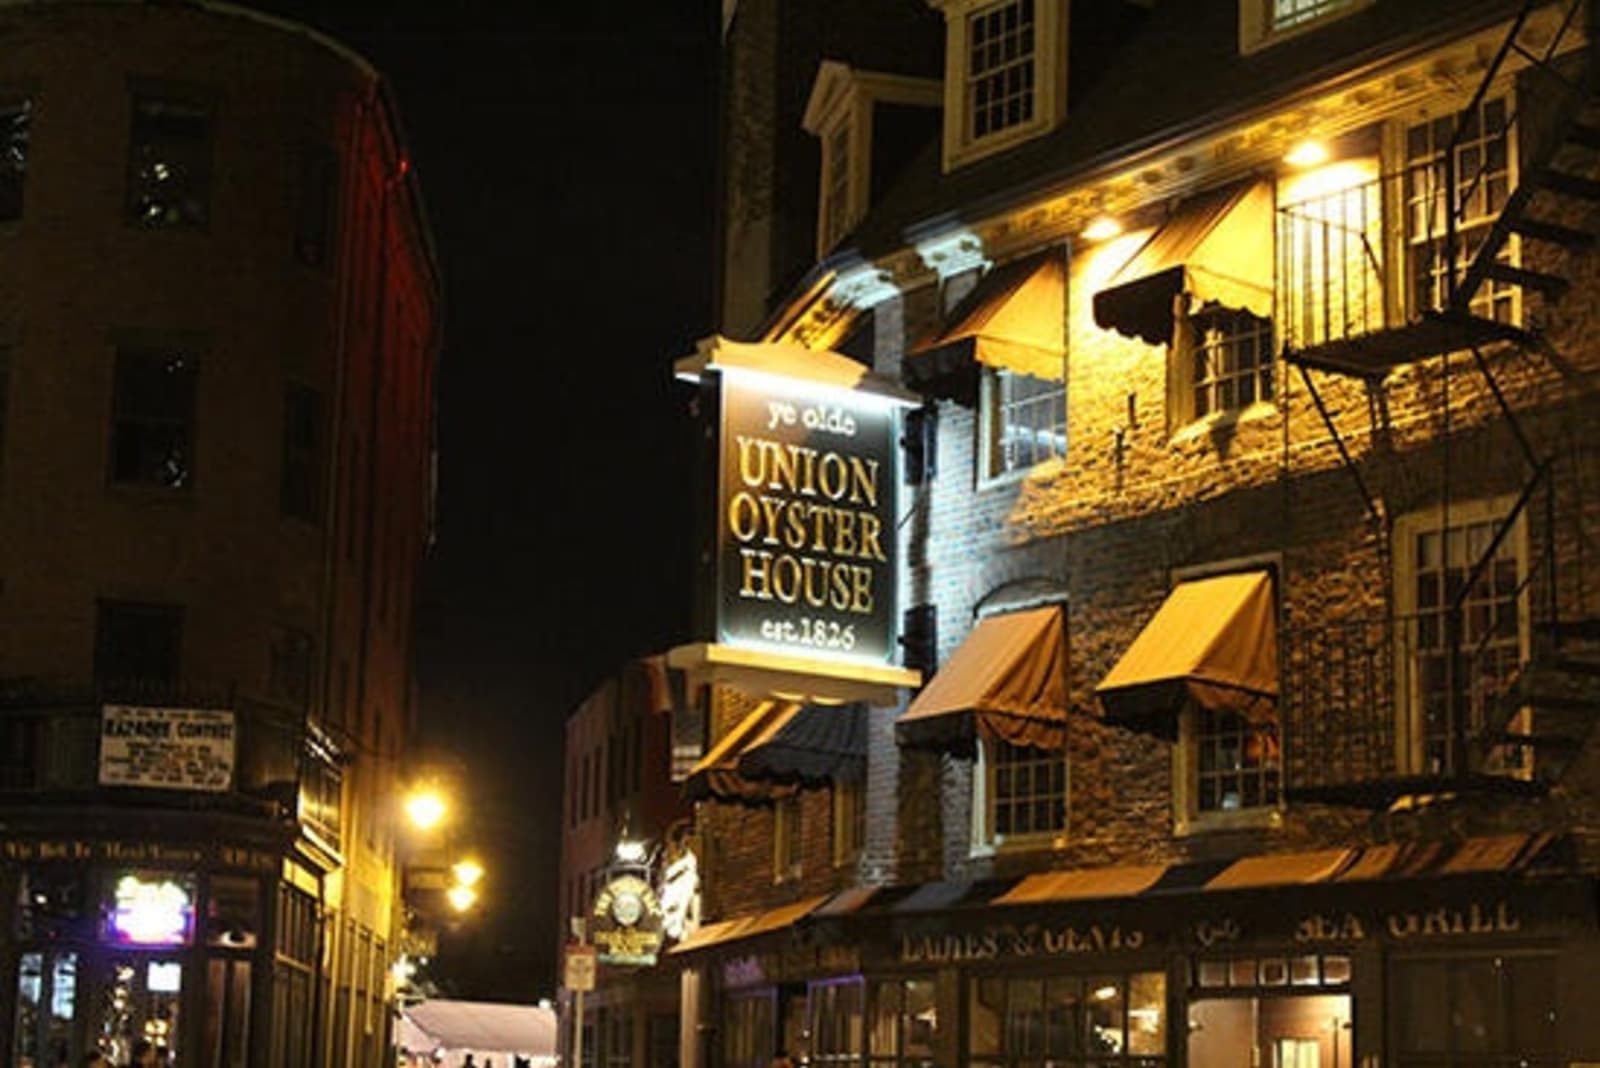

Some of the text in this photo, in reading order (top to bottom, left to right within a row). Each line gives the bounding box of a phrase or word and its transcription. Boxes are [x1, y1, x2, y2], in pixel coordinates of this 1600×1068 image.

[737, 436, 879, 507] UNION
[728, 492, 887, 562] OYSTER
[739, 549, 873, 613] HOUSE
